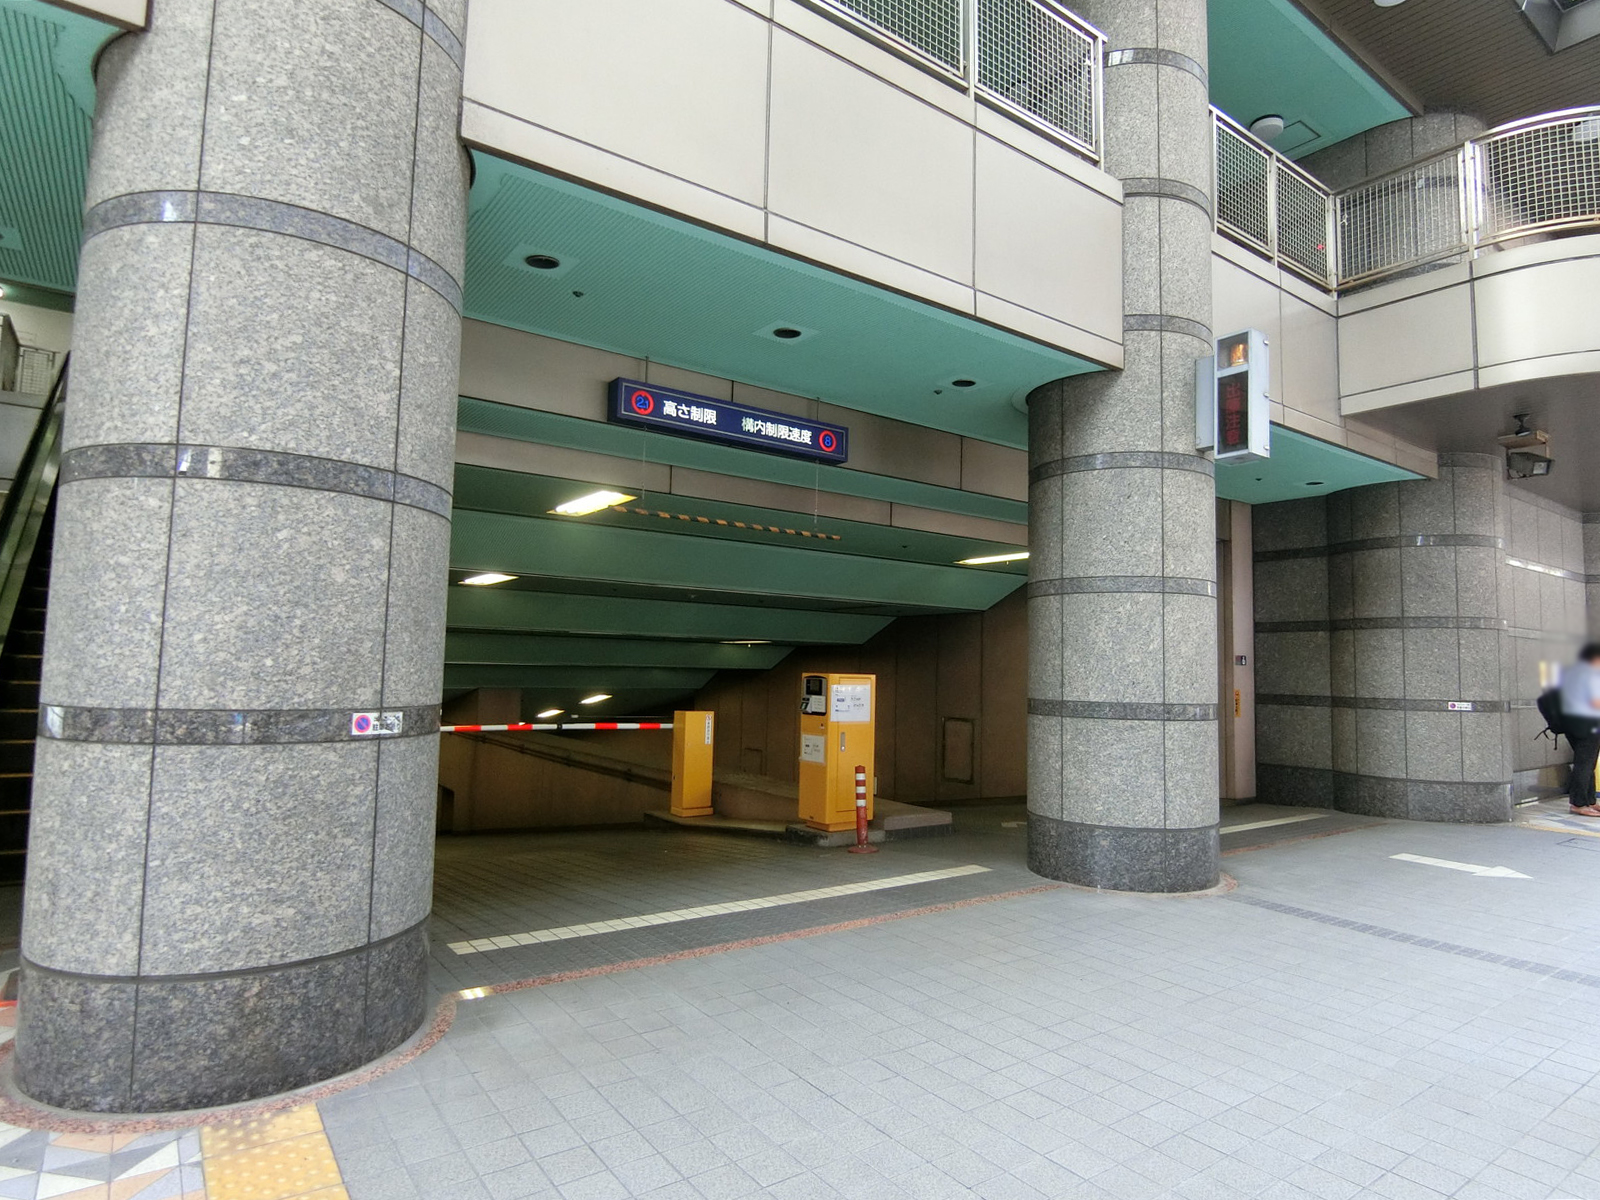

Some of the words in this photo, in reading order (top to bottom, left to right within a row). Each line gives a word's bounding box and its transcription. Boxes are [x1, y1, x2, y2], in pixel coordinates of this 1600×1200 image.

[663, 400, 717, 425] 高さ制限
[741, 416, 812, 445] 構内制限速度
[824, 435, 832, 447] 8
